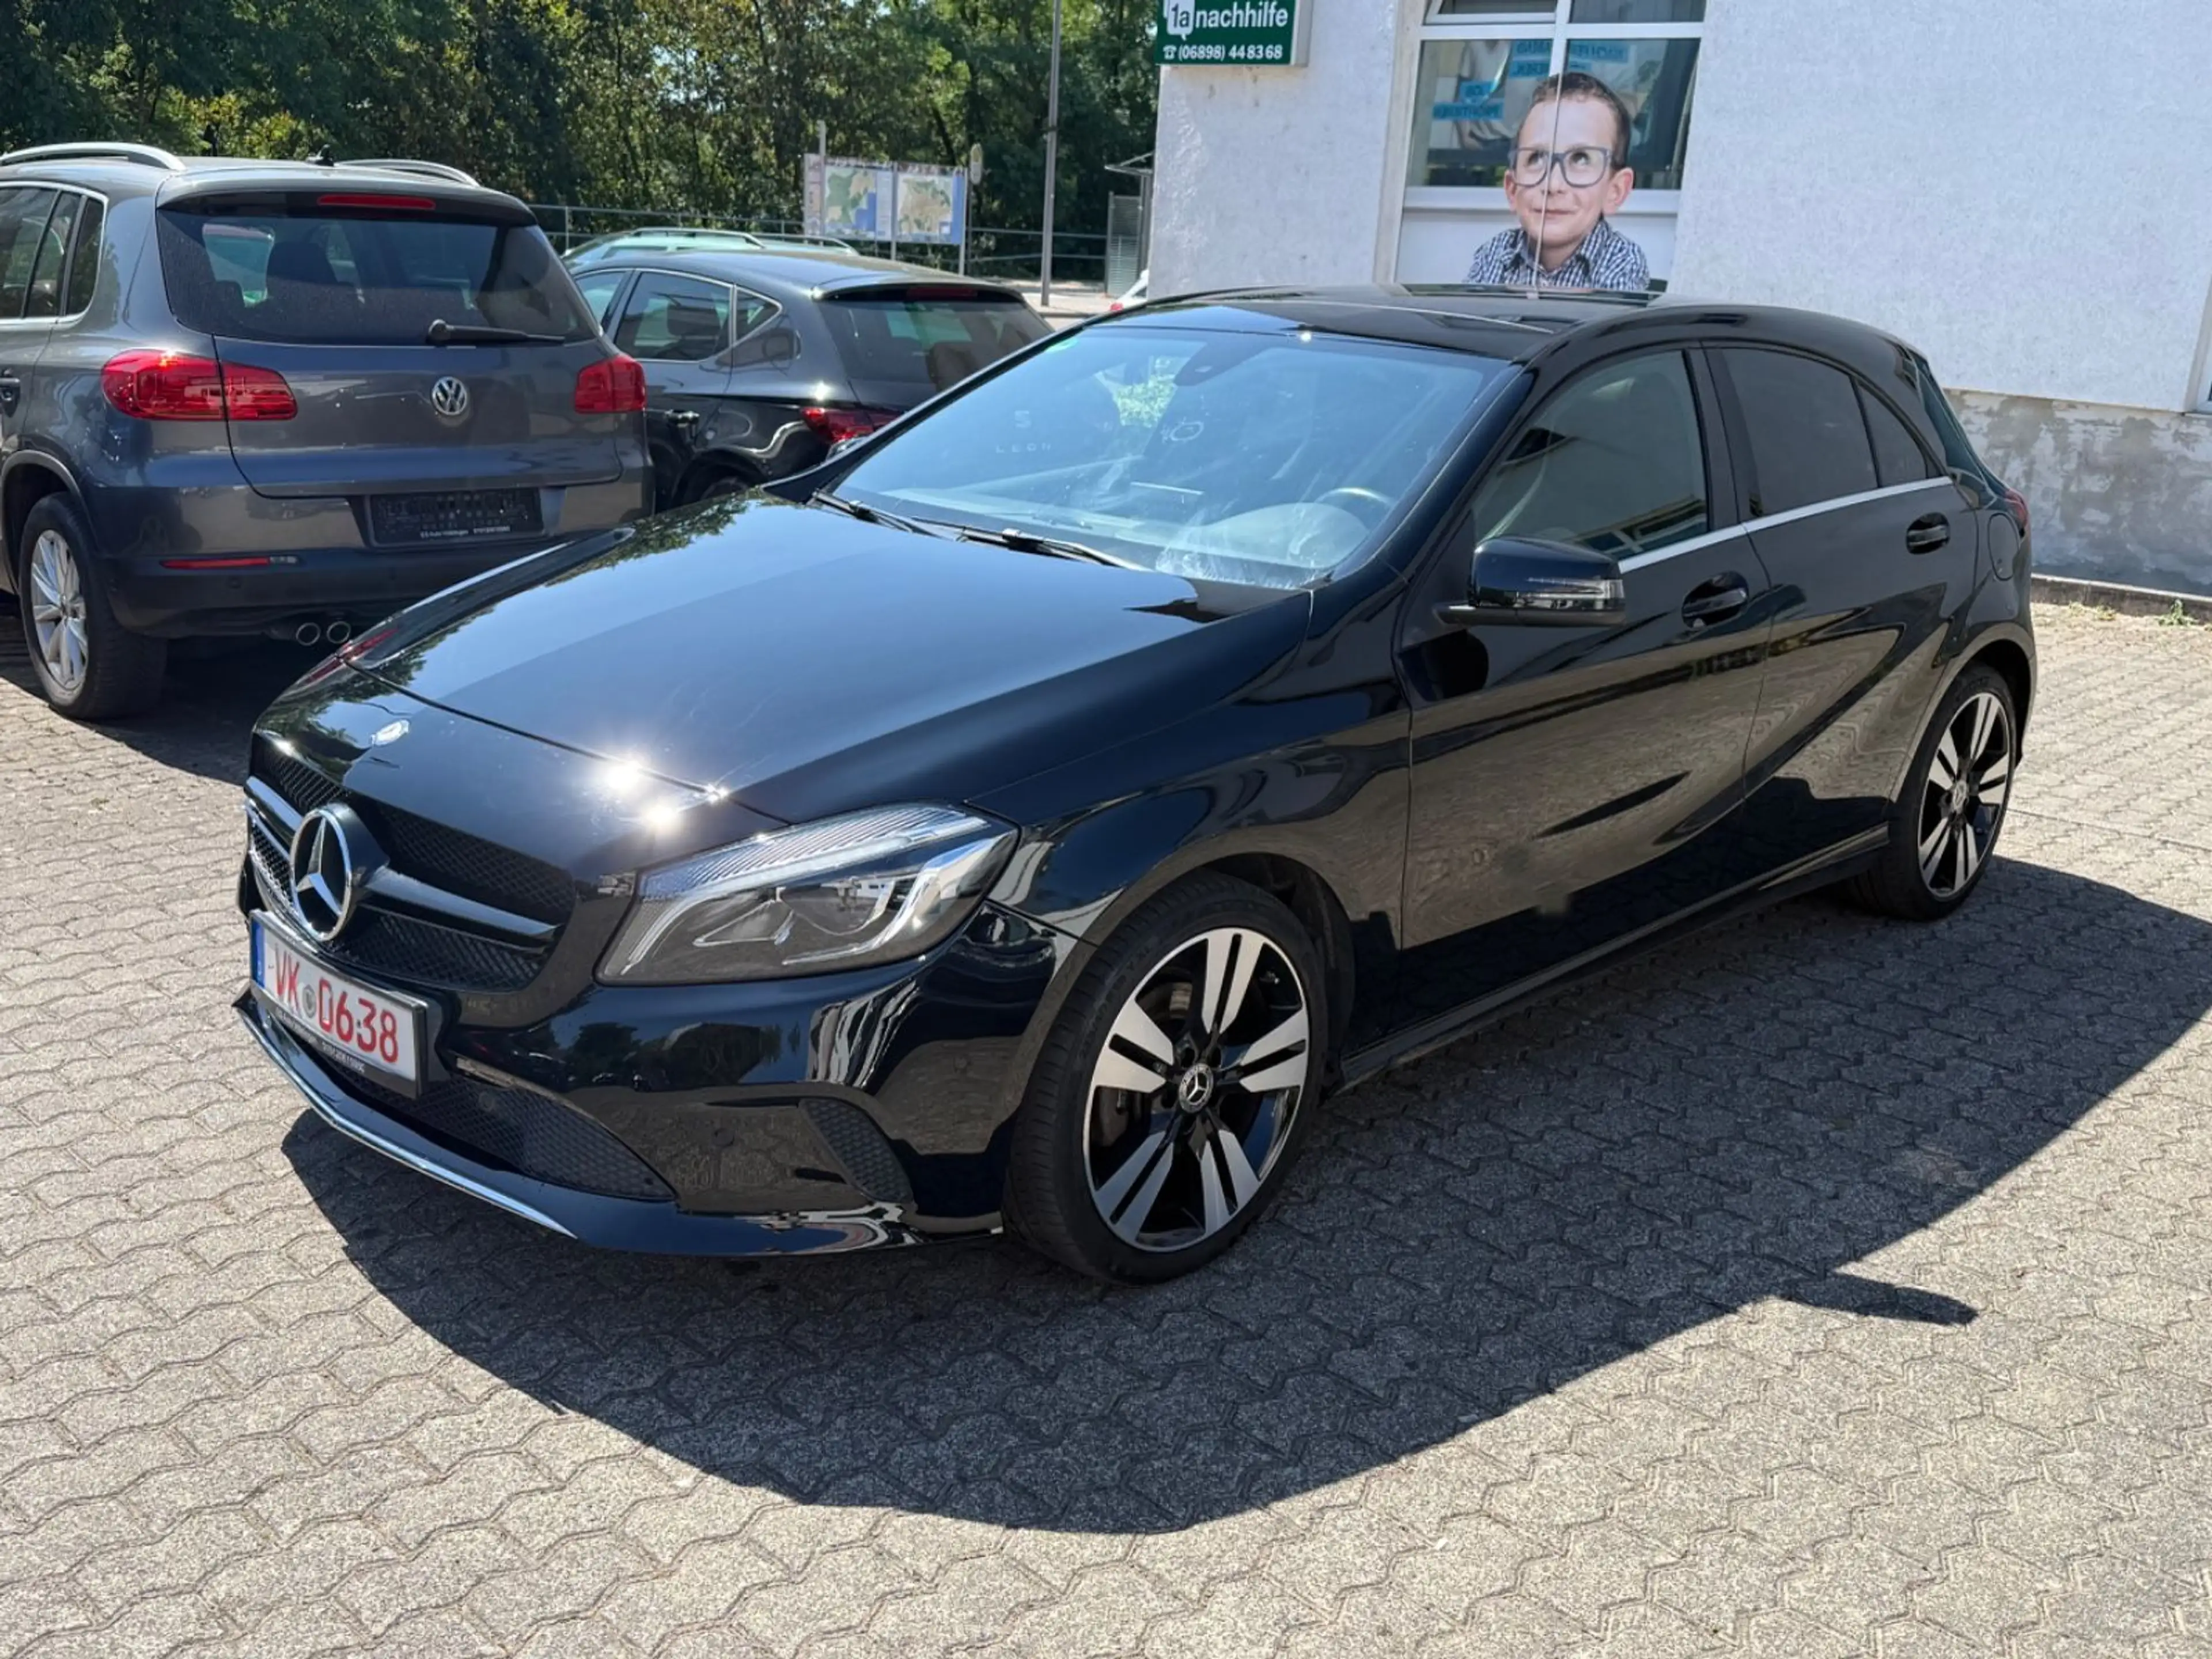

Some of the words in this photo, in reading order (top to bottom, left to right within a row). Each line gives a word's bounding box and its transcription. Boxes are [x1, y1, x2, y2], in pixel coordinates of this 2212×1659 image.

[1171, 3, 1190, 28] 1a
[1195, 1, 1289, 28] nachhilfe
[1179, 44, 1226, 62] (06898)
[275, 948, 300, 1018] VK
